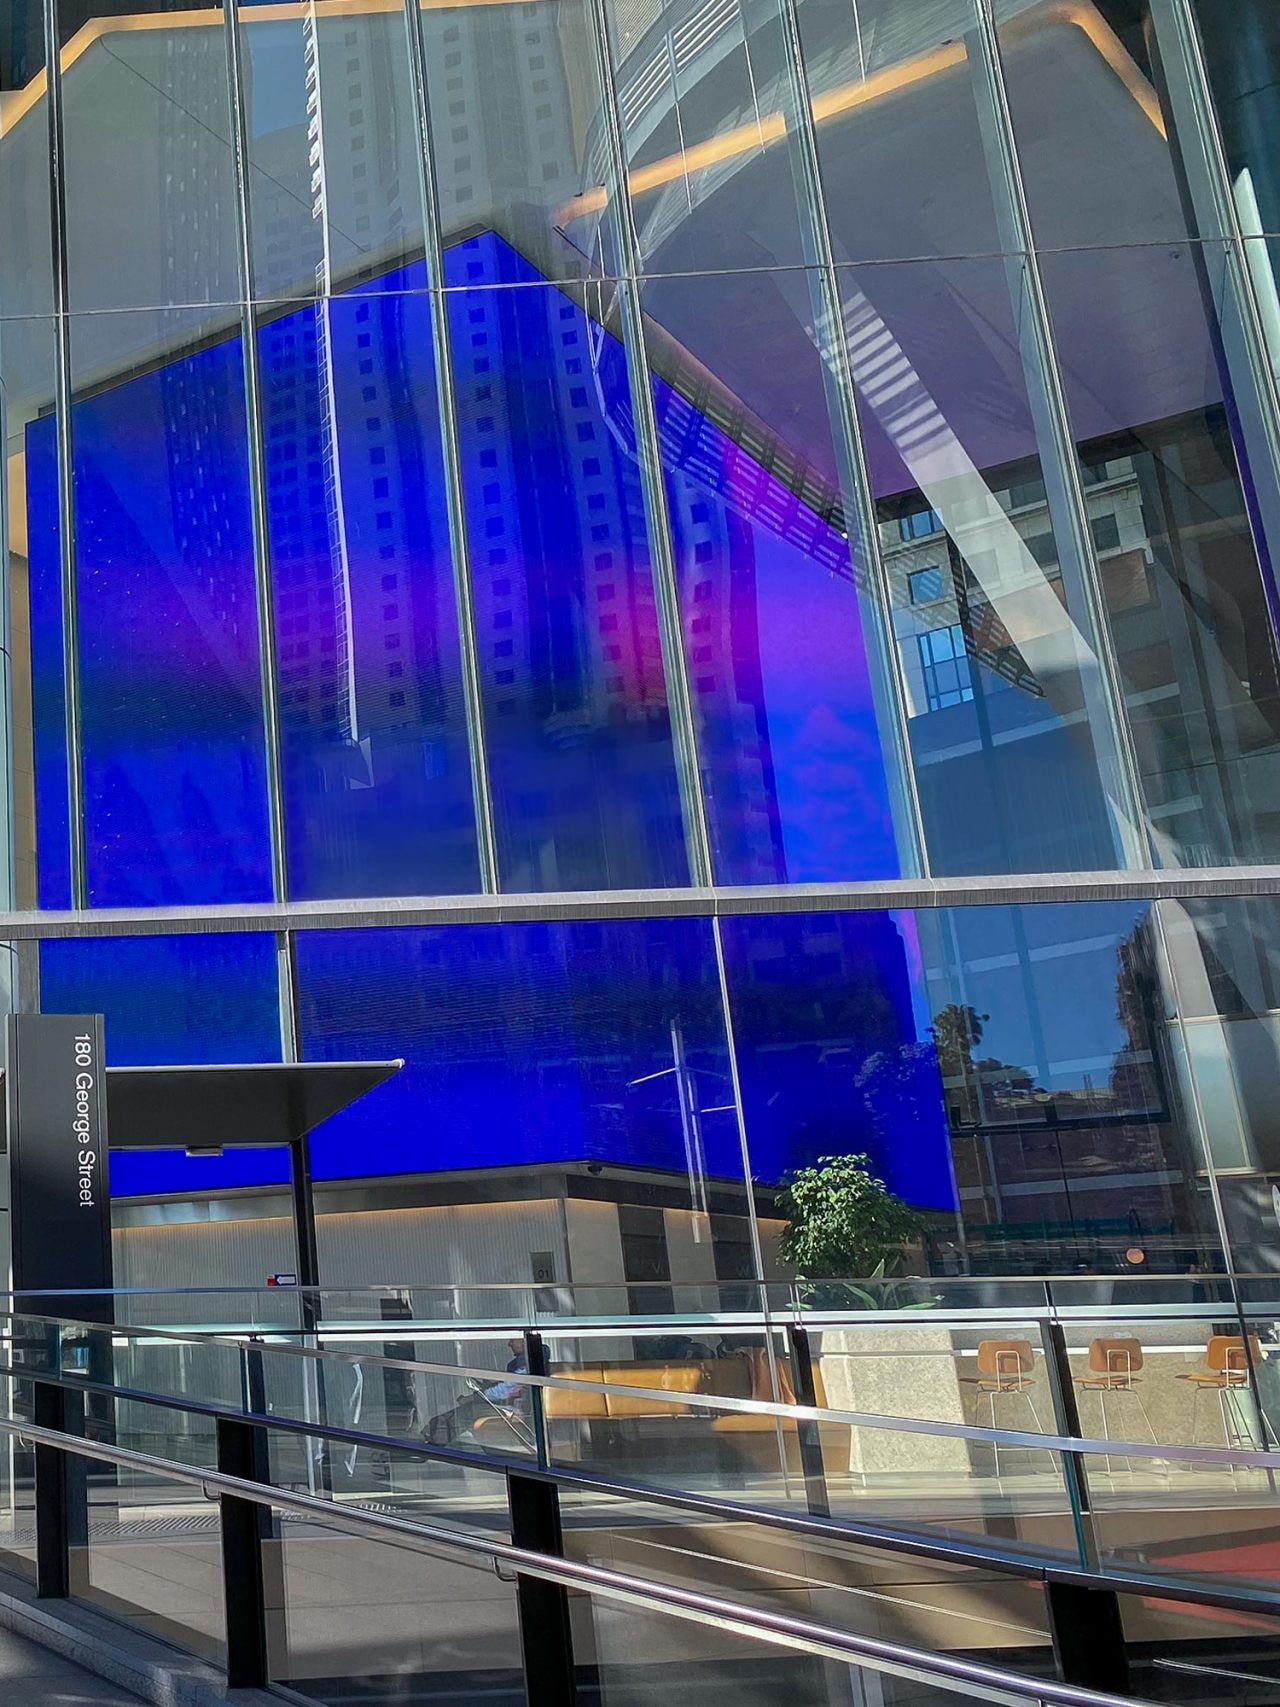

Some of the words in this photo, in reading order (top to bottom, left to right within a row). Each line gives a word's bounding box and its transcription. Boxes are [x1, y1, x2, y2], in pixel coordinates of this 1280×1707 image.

[74, 1033, 93, 1067] 180
[72, 1072, 94, 1144] George
[77, 1150, 96, 1207] Street
